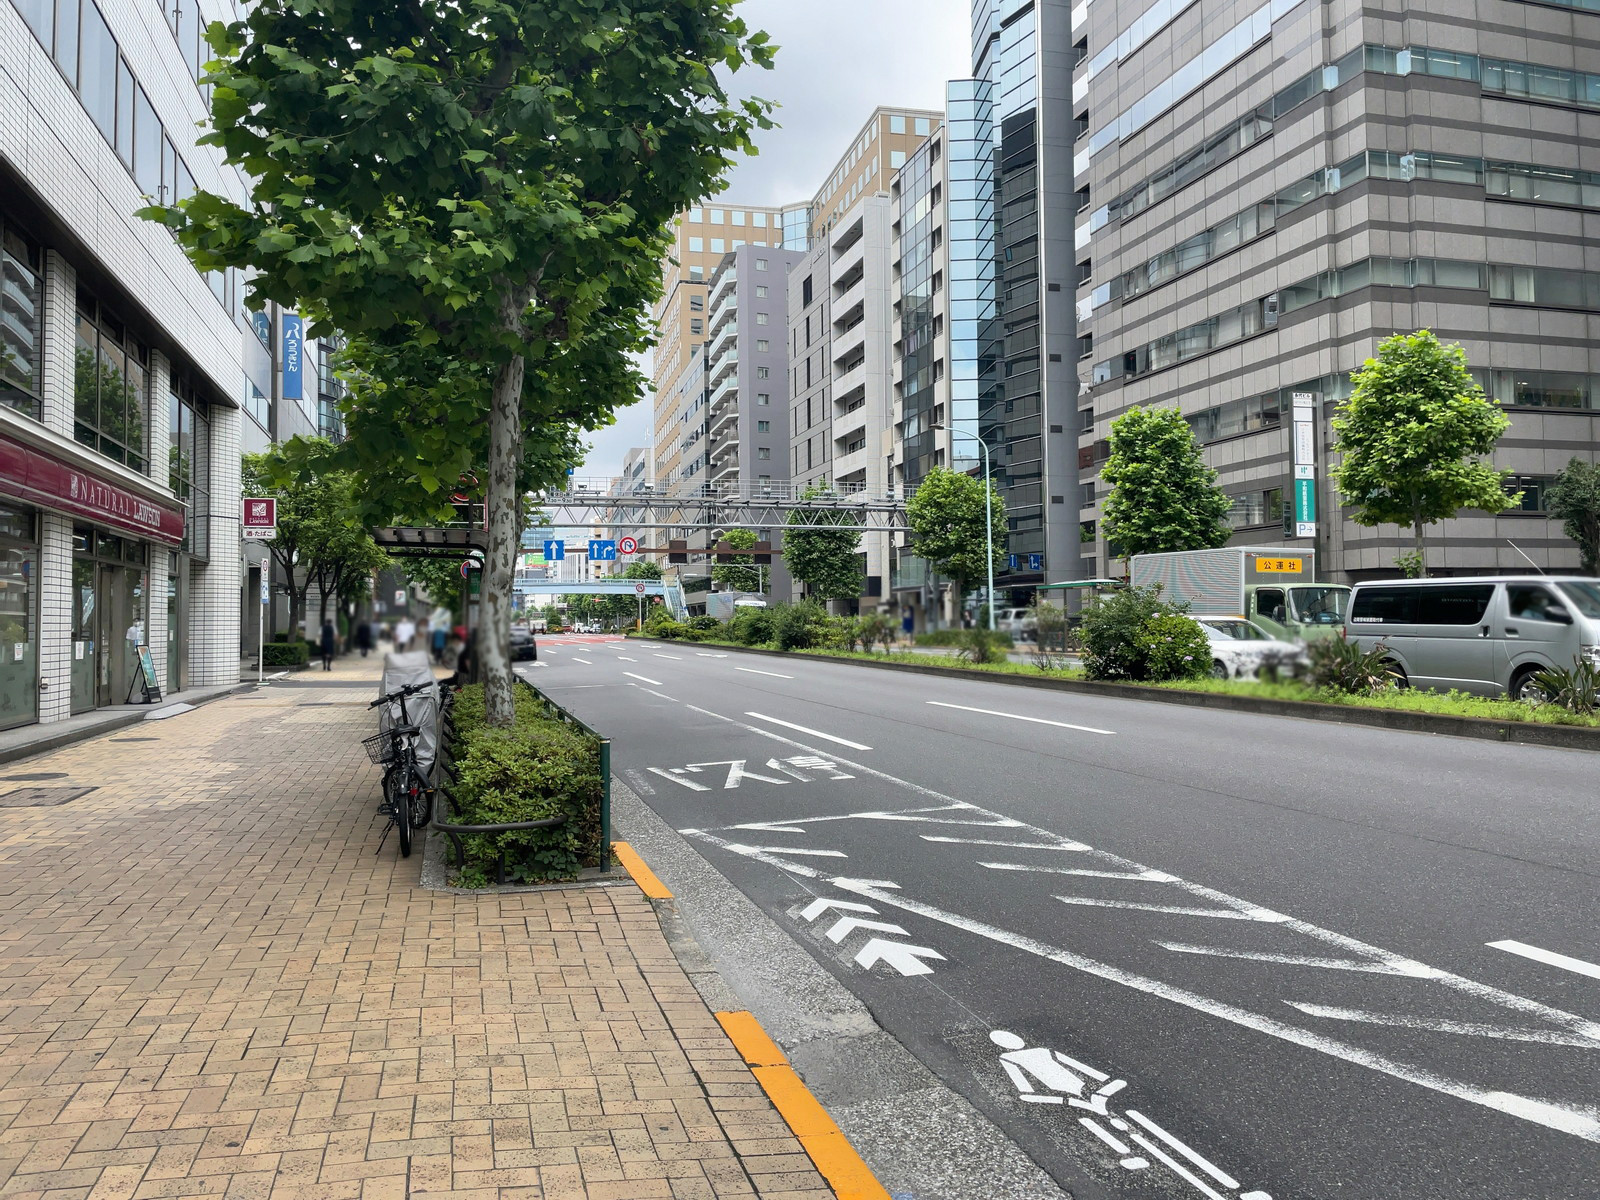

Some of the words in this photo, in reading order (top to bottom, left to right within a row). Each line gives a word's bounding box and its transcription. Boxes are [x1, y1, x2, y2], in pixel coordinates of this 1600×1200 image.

[288, 339, 297, 372] ろうきん
[80, 480, 130, 516] NATURAL
[133, 501, 160, 527] LAWSON
[1299, 524, 1306, 535] P
